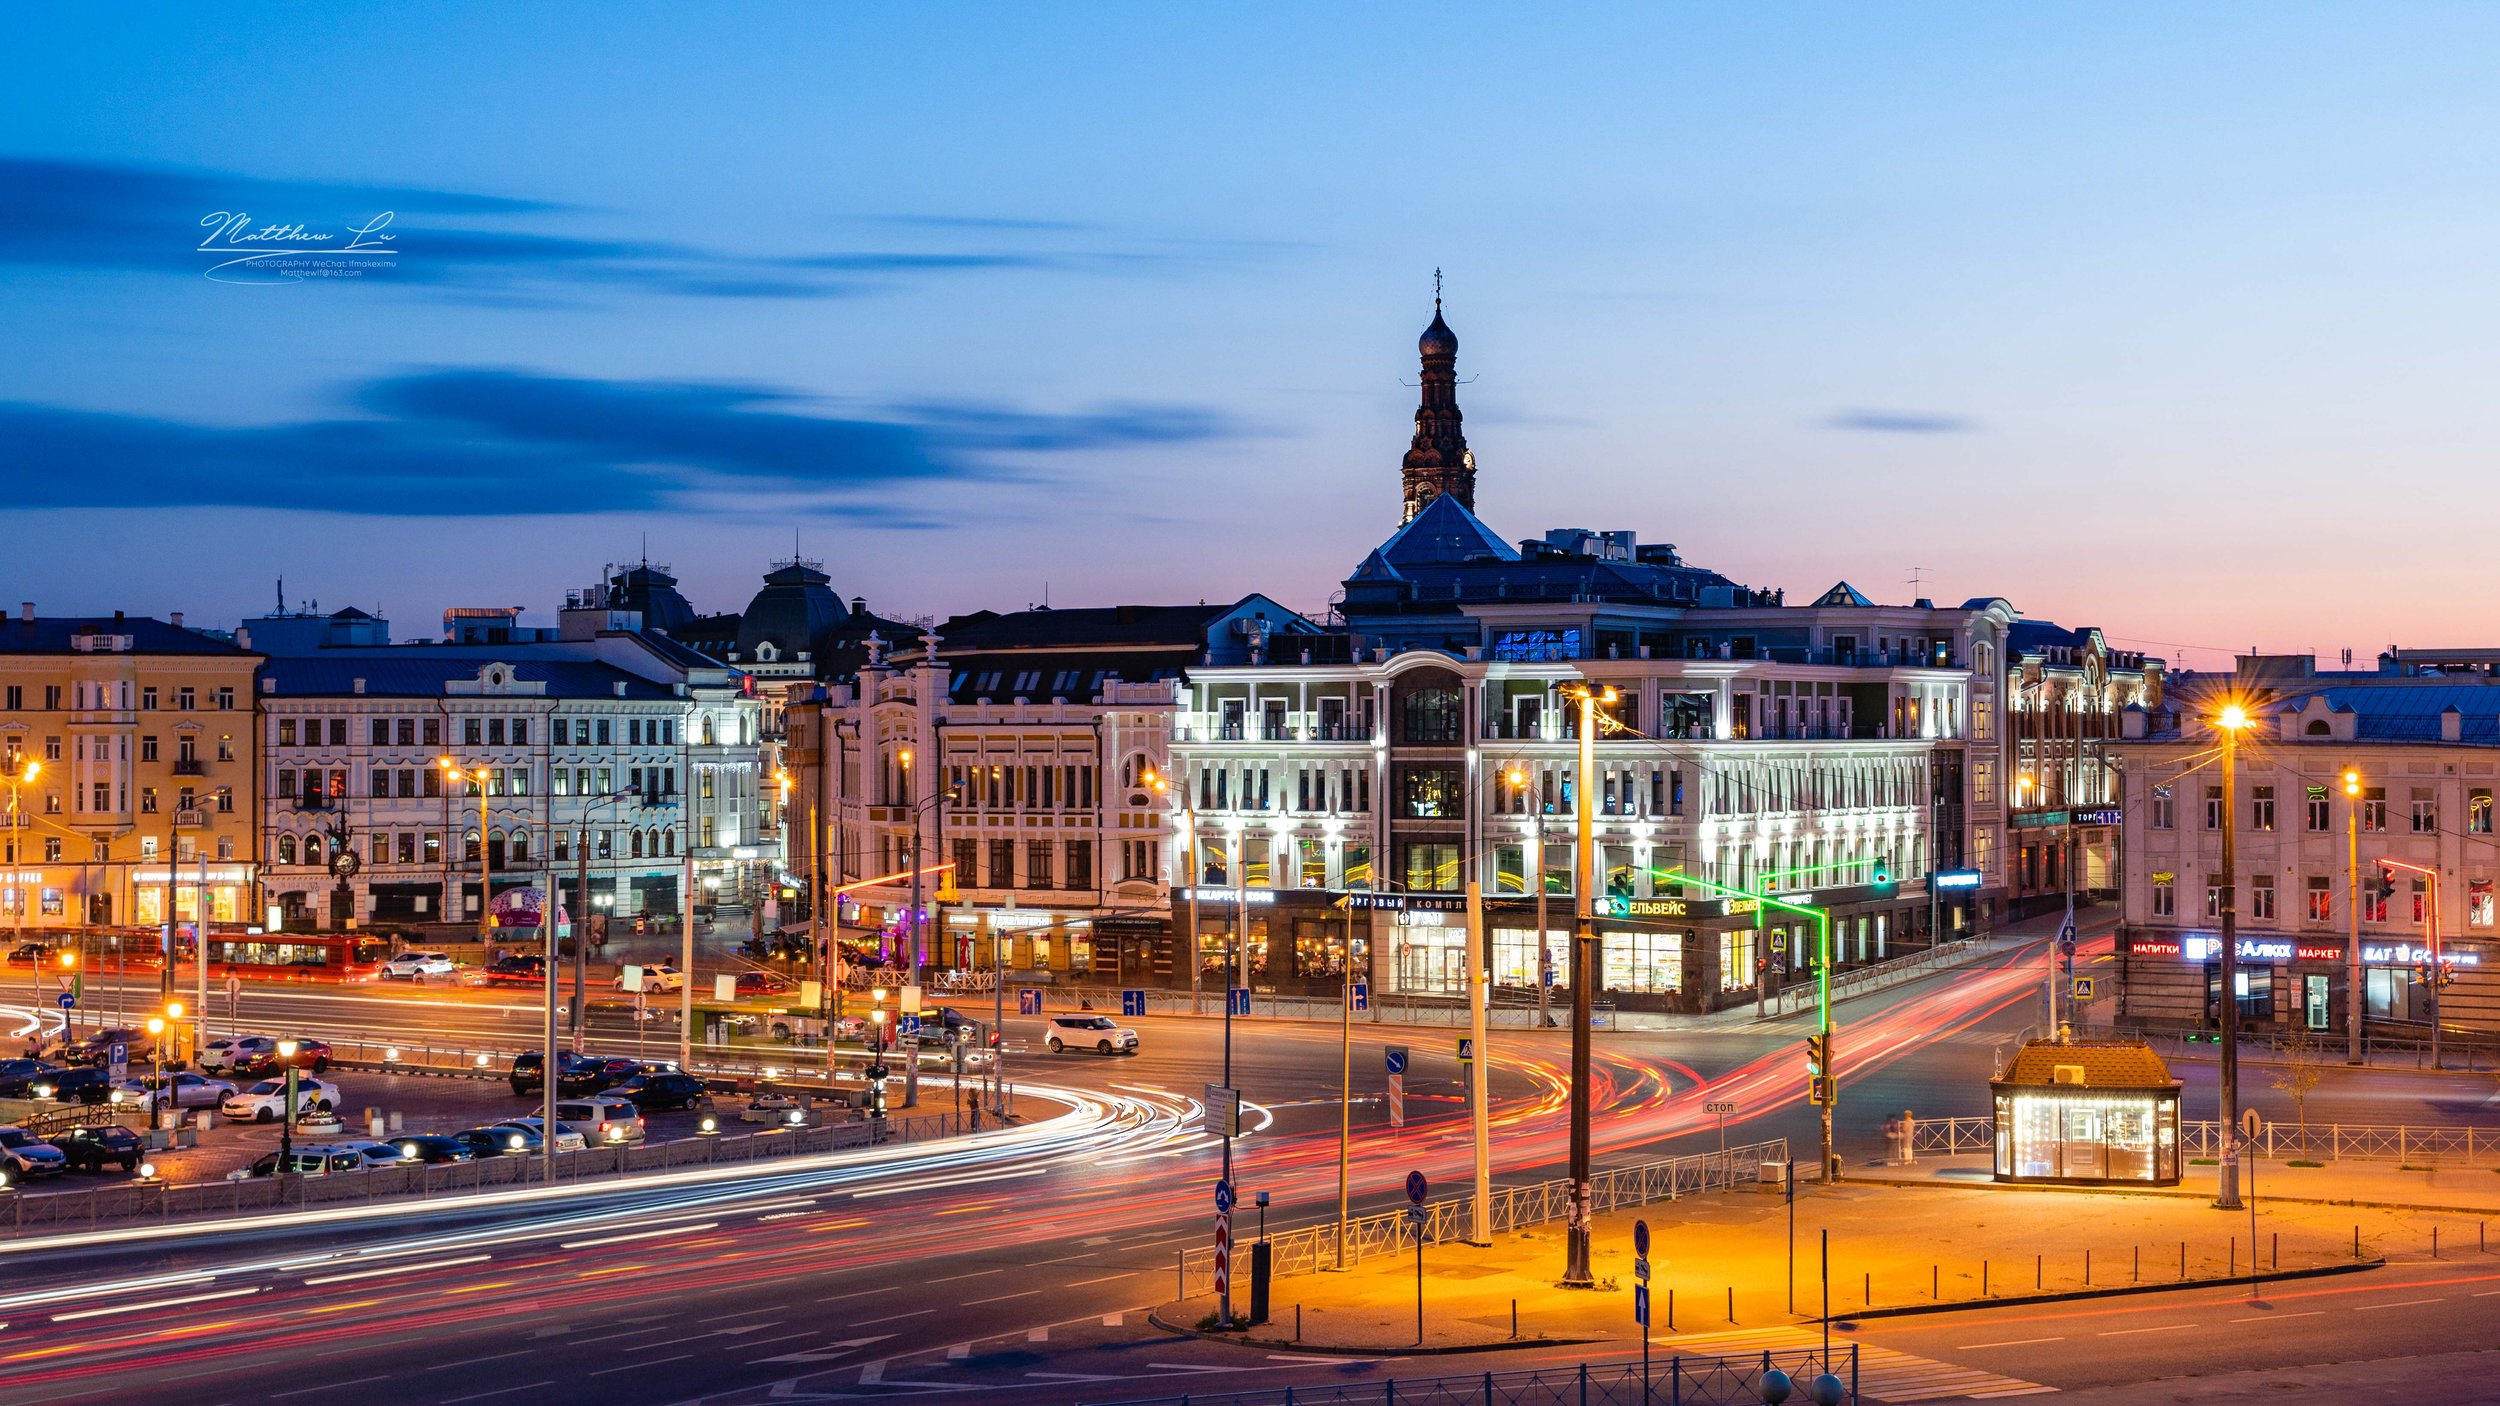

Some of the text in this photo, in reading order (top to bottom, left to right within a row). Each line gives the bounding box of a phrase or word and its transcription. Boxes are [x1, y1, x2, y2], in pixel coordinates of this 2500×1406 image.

[1611, 899, 1686, 915] ЭЕЛЬВЕЙС
[2133, 944, 2180, 954] НАПИТКИ
[2298, 949, 2341, 959] МАРКЕТ
[114, 1045, 124, 1062] P
[1706, 1103, 1734, 1112] СТОП
